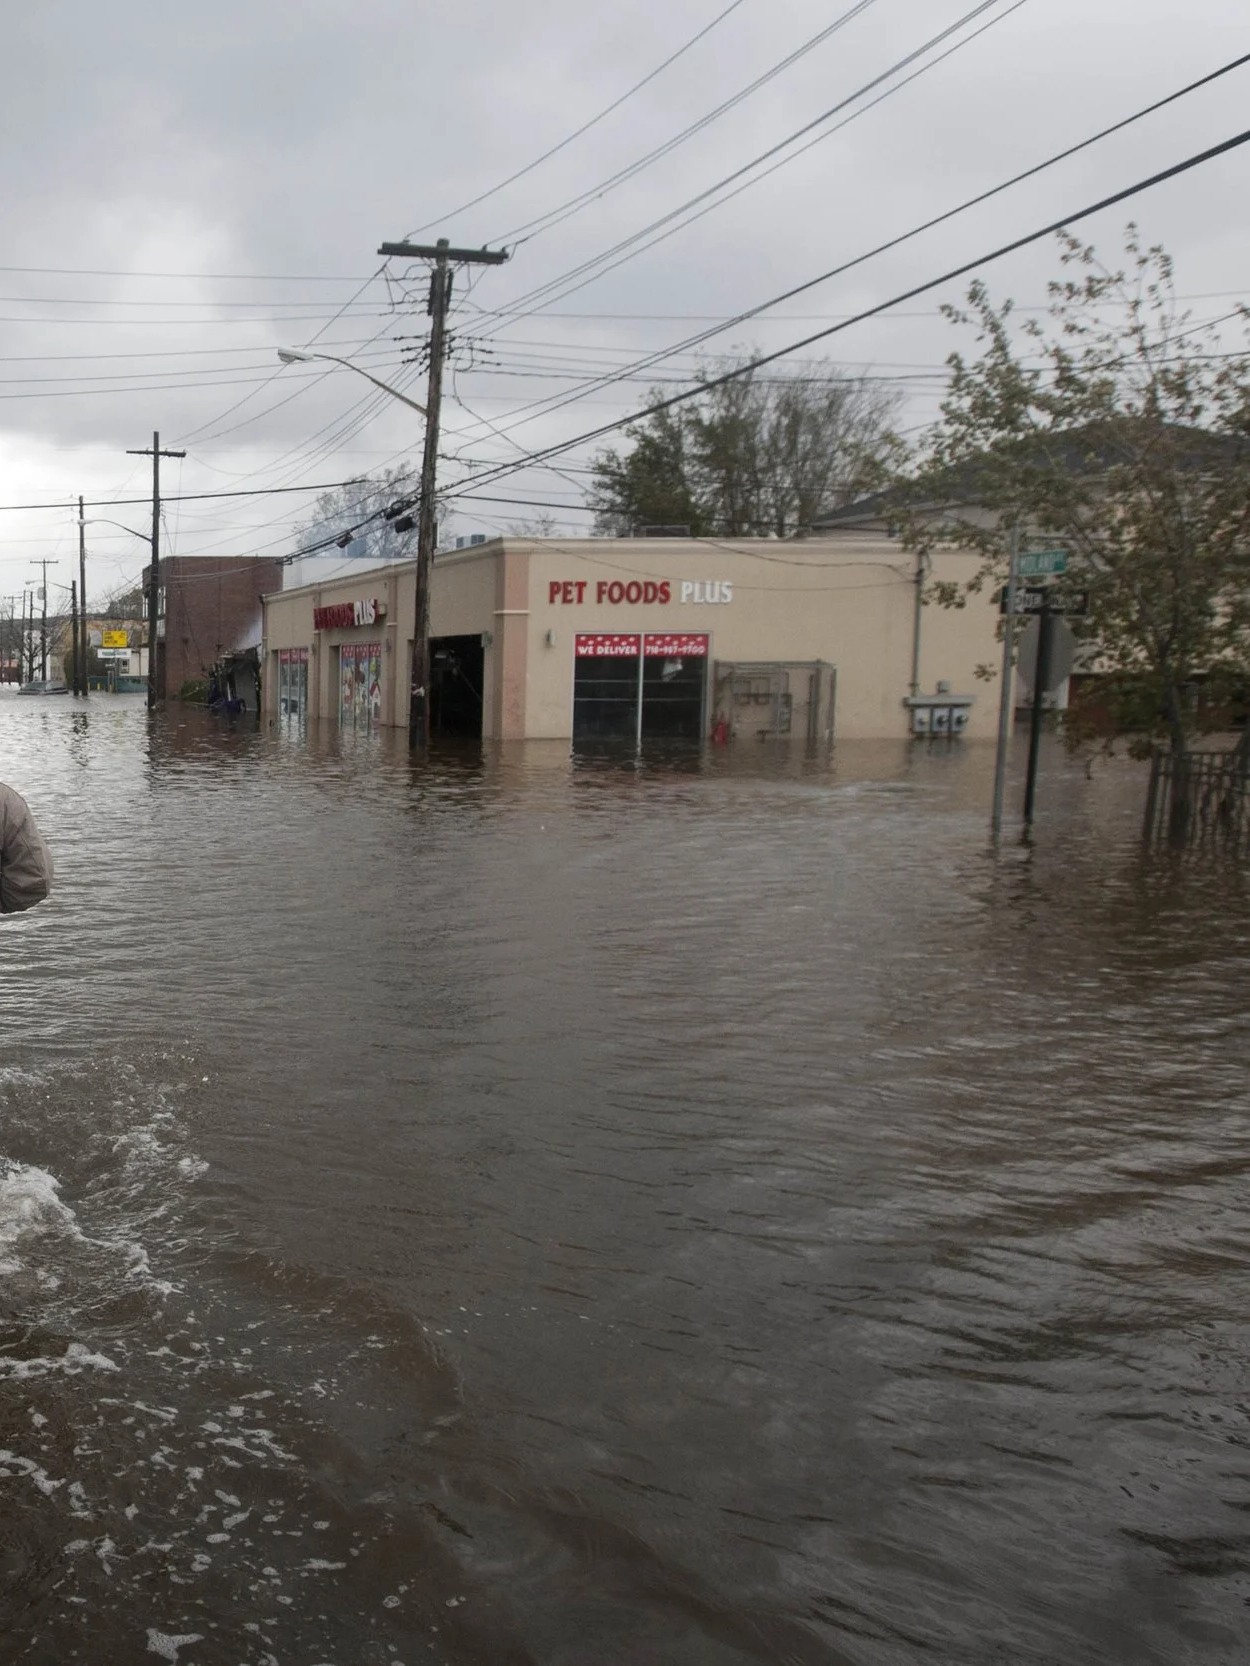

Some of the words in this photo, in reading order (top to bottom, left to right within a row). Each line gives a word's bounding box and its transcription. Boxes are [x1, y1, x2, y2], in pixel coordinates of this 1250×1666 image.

[548, 581, 587, 604] PET
[597, 581, 671, 604] FOODS
[681, 581, 733, 604] PLUS
[354, 597, 376, 626] PLUS
[577, 646, 594, 655] WE
[596, 646, 638, 655] DELIVER
